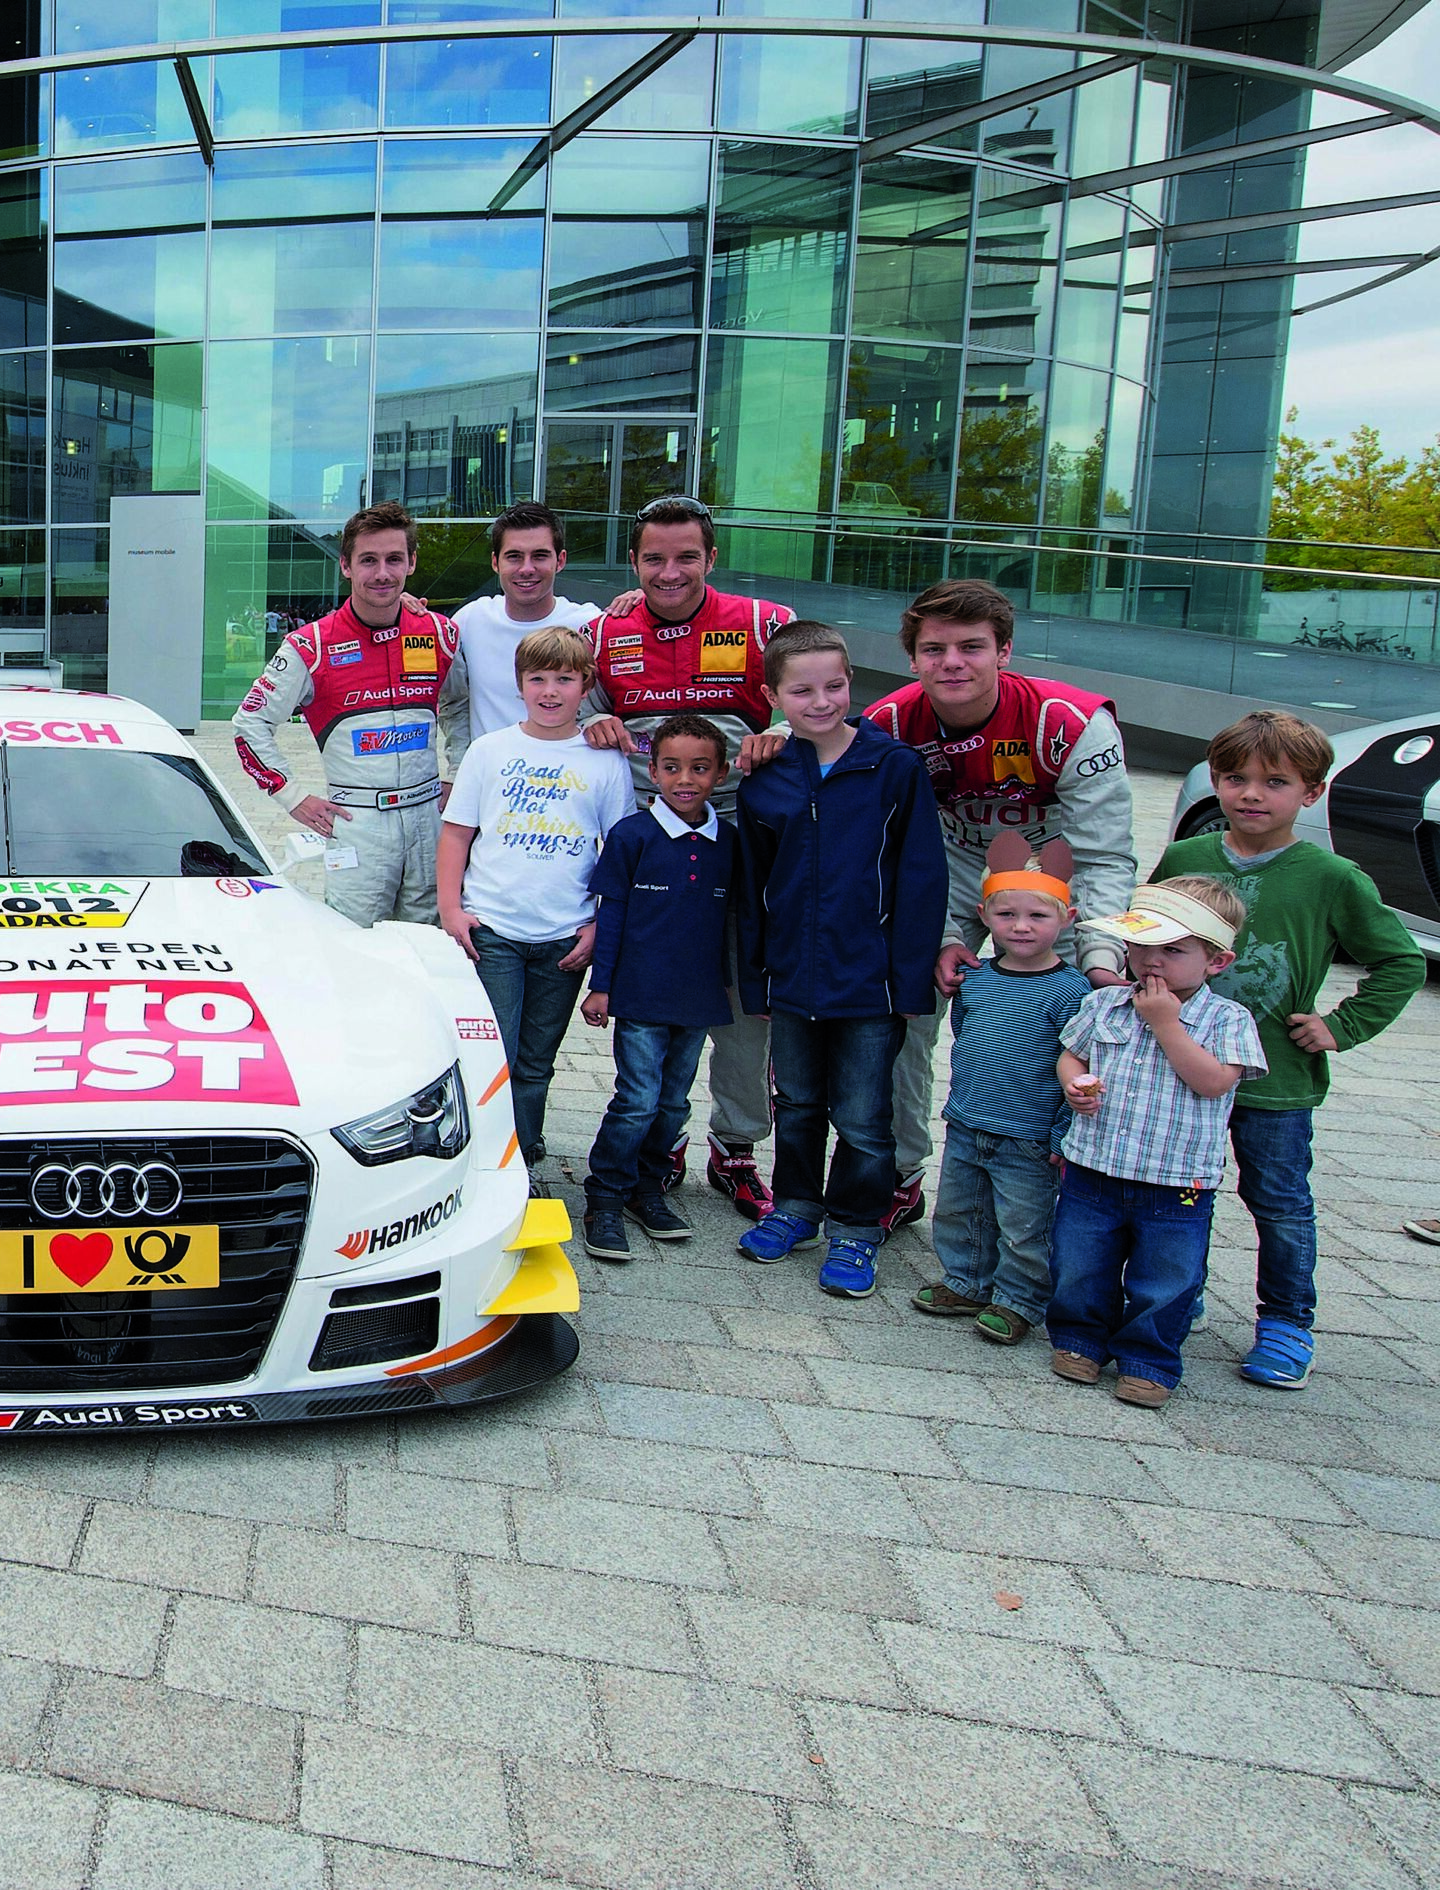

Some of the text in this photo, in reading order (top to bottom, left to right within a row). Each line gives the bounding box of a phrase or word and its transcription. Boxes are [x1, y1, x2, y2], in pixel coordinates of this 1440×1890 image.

[403, 636, 434, 650] ADAC
[703, 632, 746, 647] ADAC
[362, 685, 434, 701] Audi Sport
[642, 687, 734, 702] Audi Sport
[501, 758, 565, 780] Read
[502, 776, 570, 801] Books
[509, 795, 548, 815] Not
[69, 942, 223, 955] JEDEN
[138, 959, 234, 973] NEU
[458, 1019, 495, 1030] auto
[460, 1031, 496, 1039] TEST
[33, 1403, 247, 1425] Audi Sport
